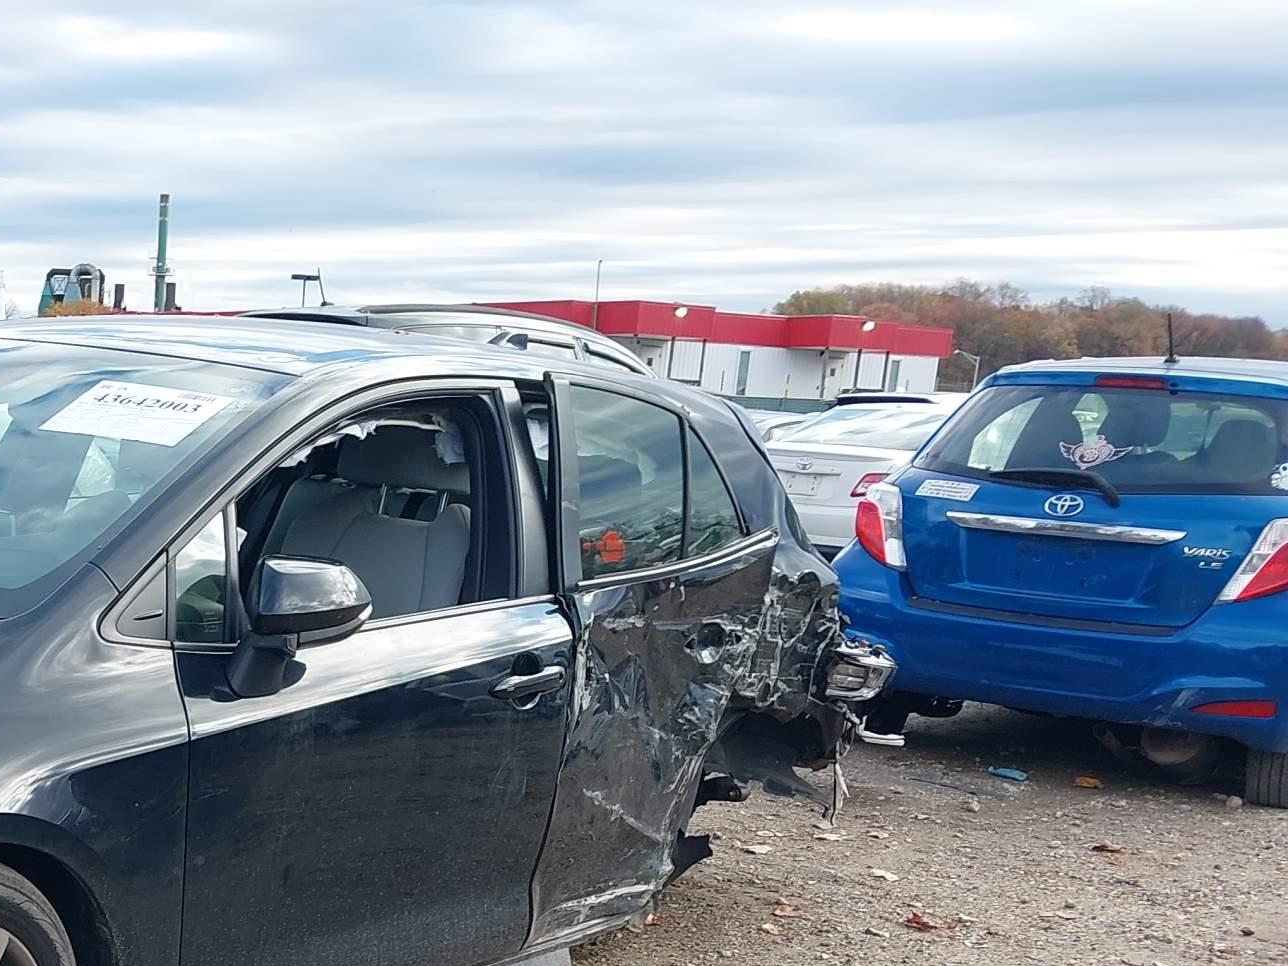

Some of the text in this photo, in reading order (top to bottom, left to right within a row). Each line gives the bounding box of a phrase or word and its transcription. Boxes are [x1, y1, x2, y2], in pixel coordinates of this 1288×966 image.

[93, 393, 202, 414] 43642003
[1183, 546, 1232, 560] YARIS
[1198, 561, 1224, 569] LE
